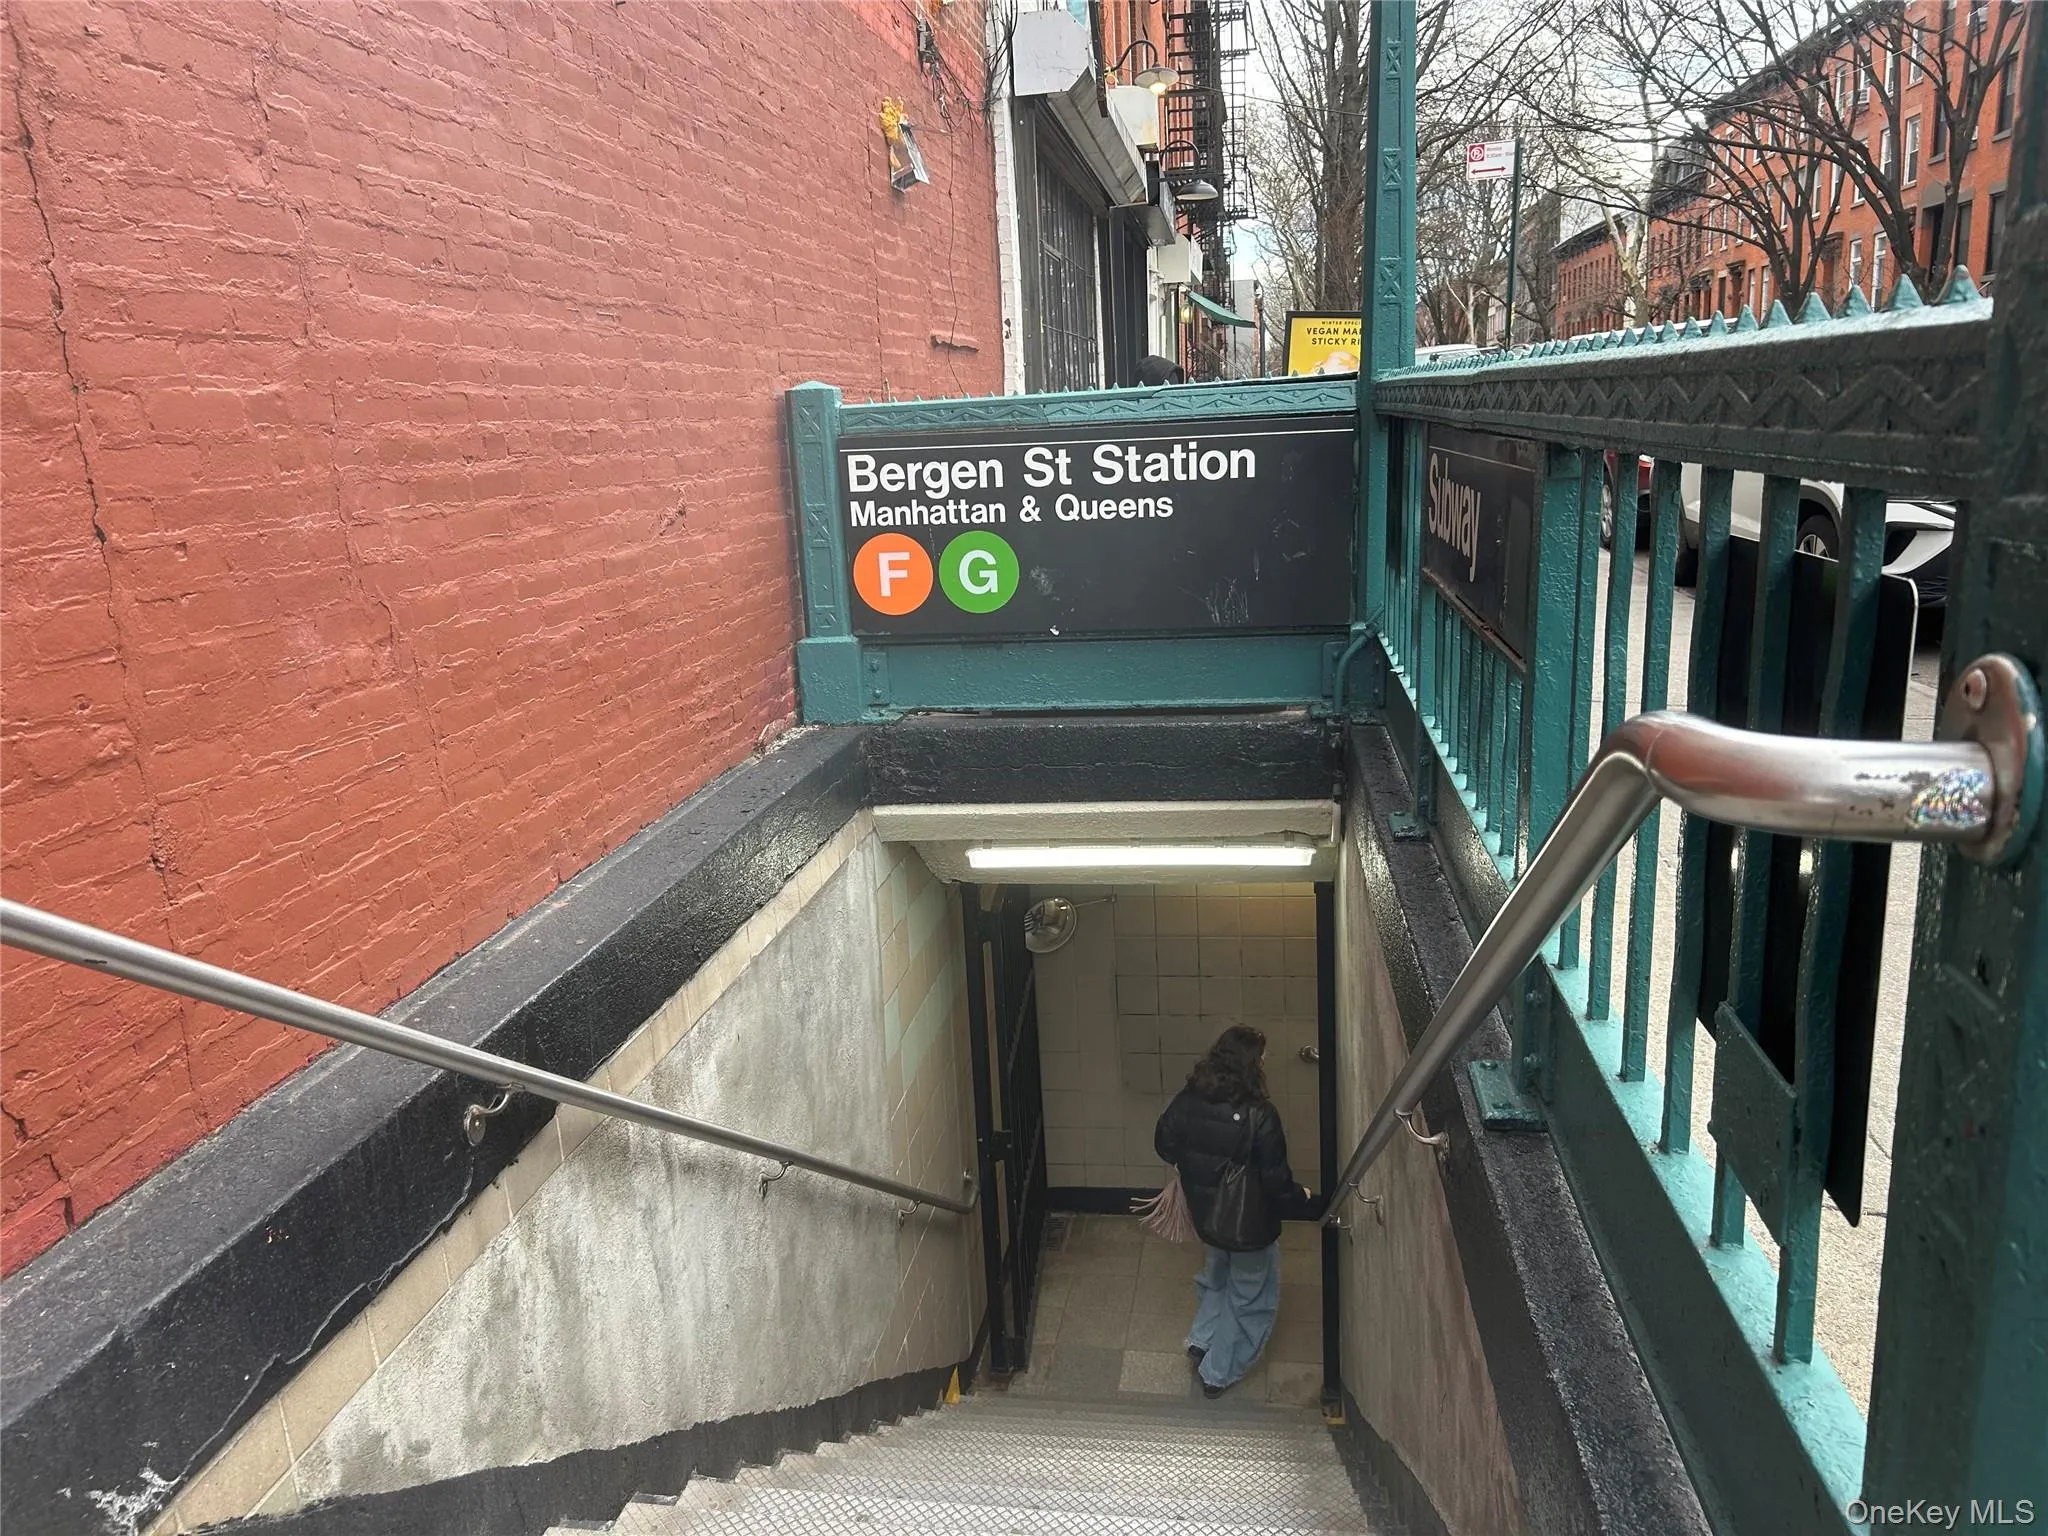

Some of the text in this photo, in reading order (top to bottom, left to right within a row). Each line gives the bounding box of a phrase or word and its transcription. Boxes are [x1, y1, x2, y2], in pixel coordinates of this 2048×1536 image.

[847, 441, 1256, 498] Bergen St Station
[850, 493, 1174, 527] Manhattan & Queens
[1428, 452, 1481, 583] Subway
[878, 549, 999, 597] F G
